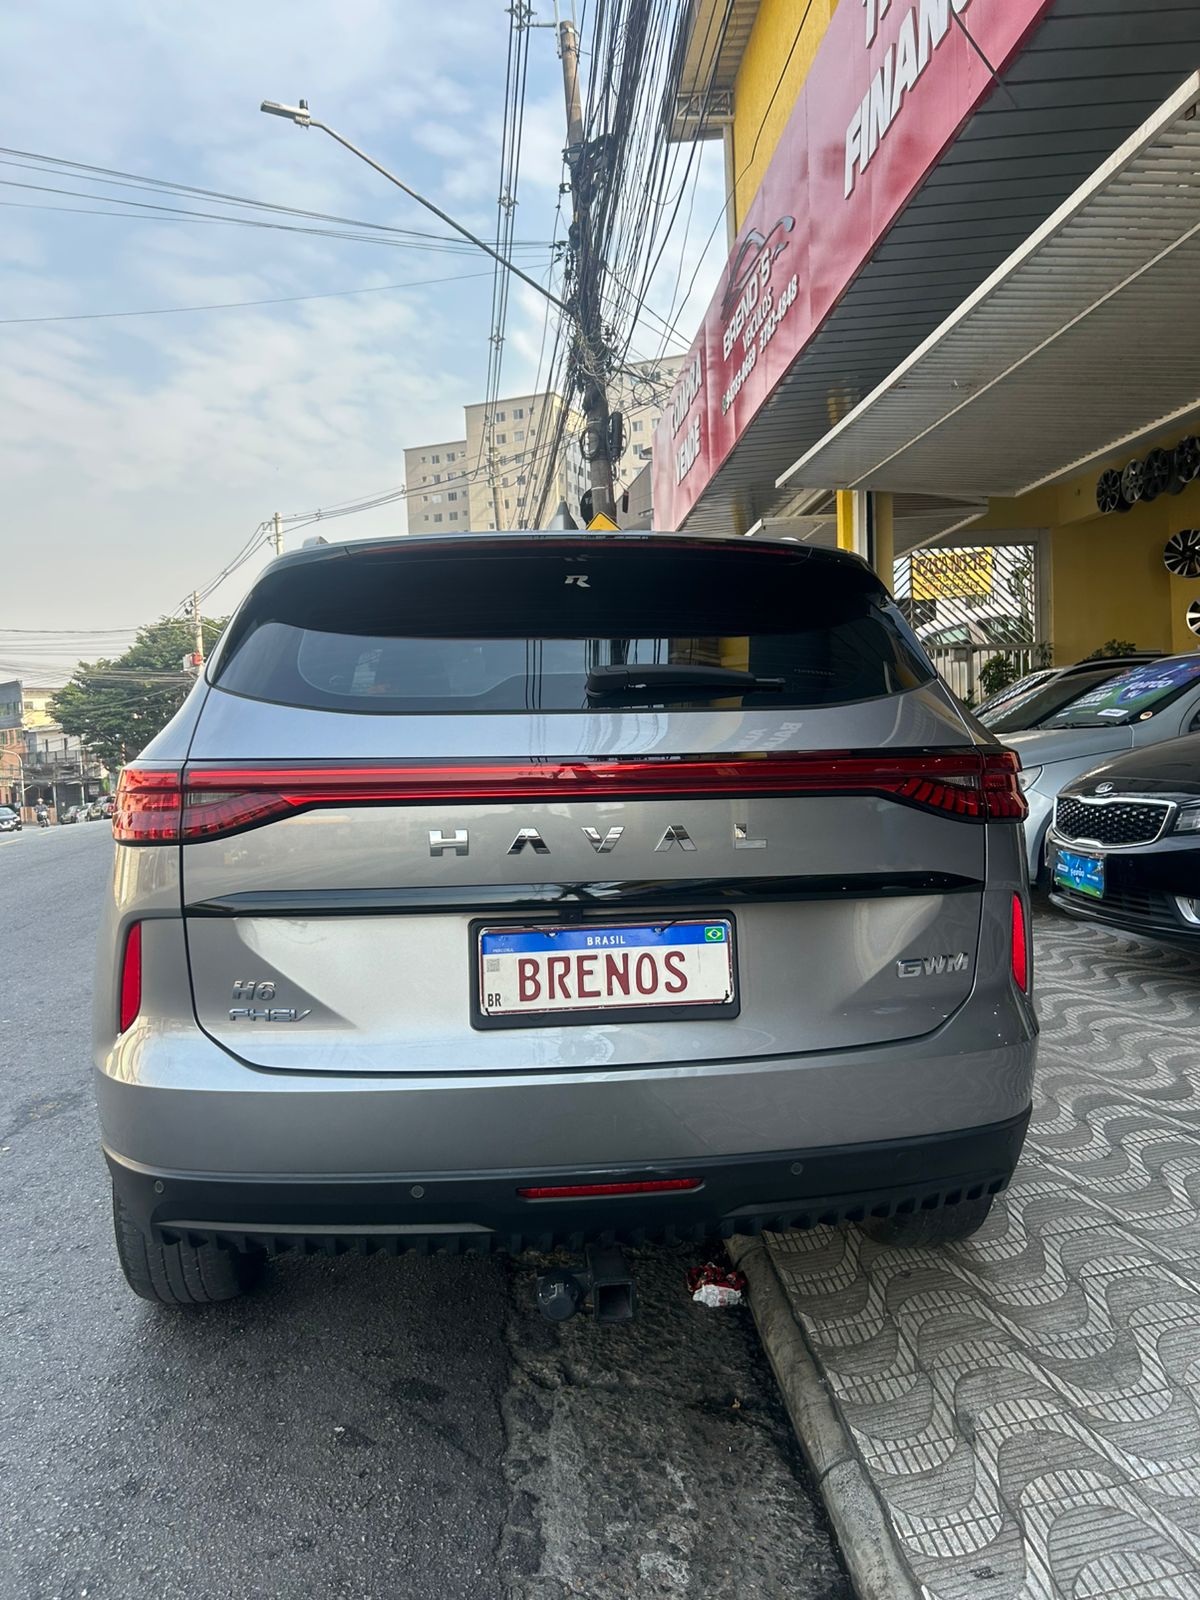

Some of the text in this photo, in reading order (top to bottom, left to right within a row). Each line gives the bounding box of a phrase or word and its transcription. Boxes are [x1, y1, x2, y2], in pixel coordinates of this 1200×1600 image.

[844, 0, 970, 200] FINAN
[722, 248, 773, 362] BRENO'S
[672, 349, 703, 440] COMPRA
[675, 413, 702, 487] VENDE
[428, 823, 768, 857] HAVAL
[586, 935, 627, 946] BRASIL
[517, 950, 689, 1003] BRENOS
[896, 952, 969, 979] GWM
[231, 980, 276, 1001] H6
[487, 993, 502, 1008] BR
